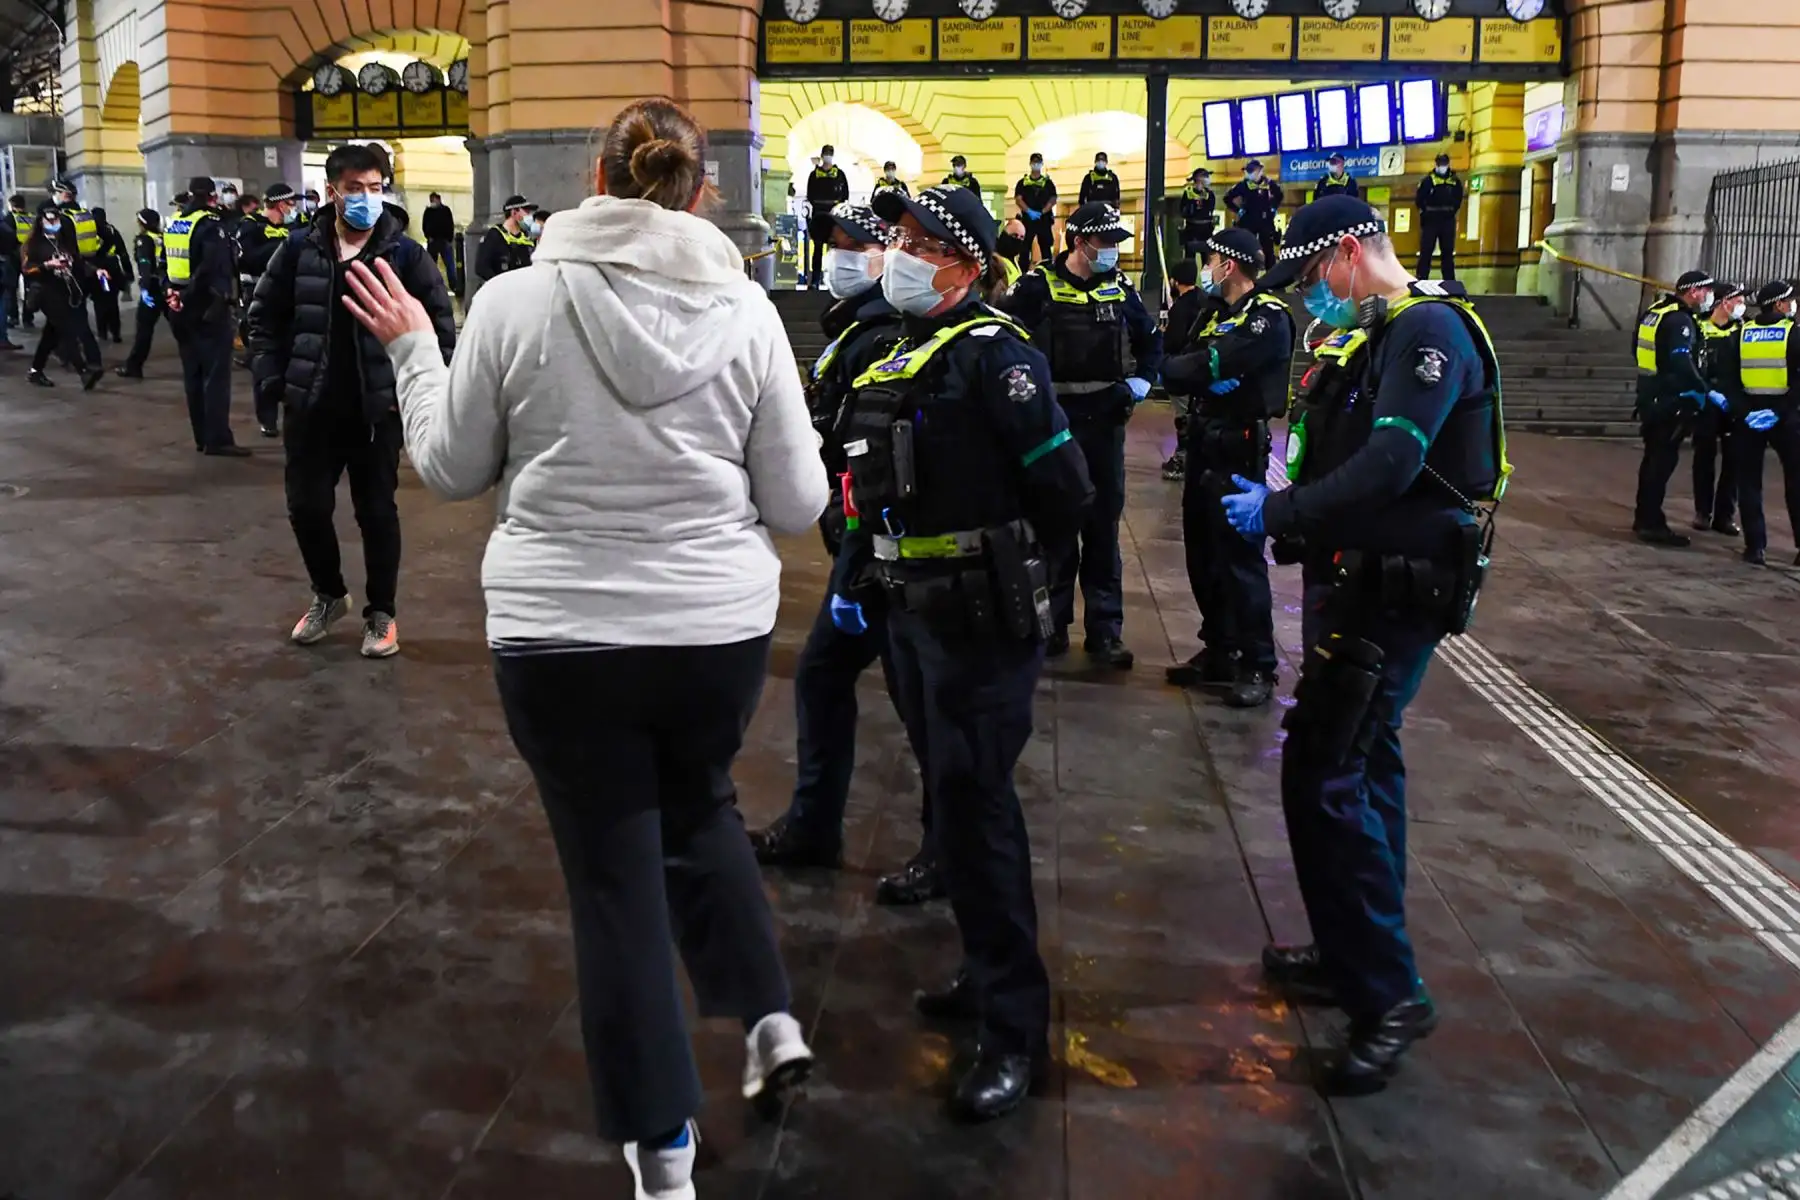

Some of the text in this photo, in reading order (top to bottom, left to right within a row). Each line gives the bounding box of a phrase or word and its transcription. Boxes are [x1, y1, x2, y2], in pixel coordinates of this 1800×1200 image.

[852, 23, 902, 33] FRANKSTON
[942, 22, 1004, 32] SANDRINGHAM
[1032, 20, 1097, 30] WILLIAMSTOWN
[1122, 20, 1156, 29] ALTONA
[1212, 20, 1258, 30] ST ALBANS
[1303, 21, 1377, 31] BROADMEADOWS
[852, 35, 870, 45] LINE
[942, 34, 960, 44] LINE
[1032, 32, 1051, 42] LINE
[1121, 31, 1140, 41] LINE
[1212, 32, 1231, 42] LINE
[1303, 33, 1320, 42] LINE
[1394, 33, 1412, 43] LINE
[1484, 34, 1502, 44] LINE
[1290, 159, 1331, 171] Custom
[1744, 329, 1784, 341] Police
